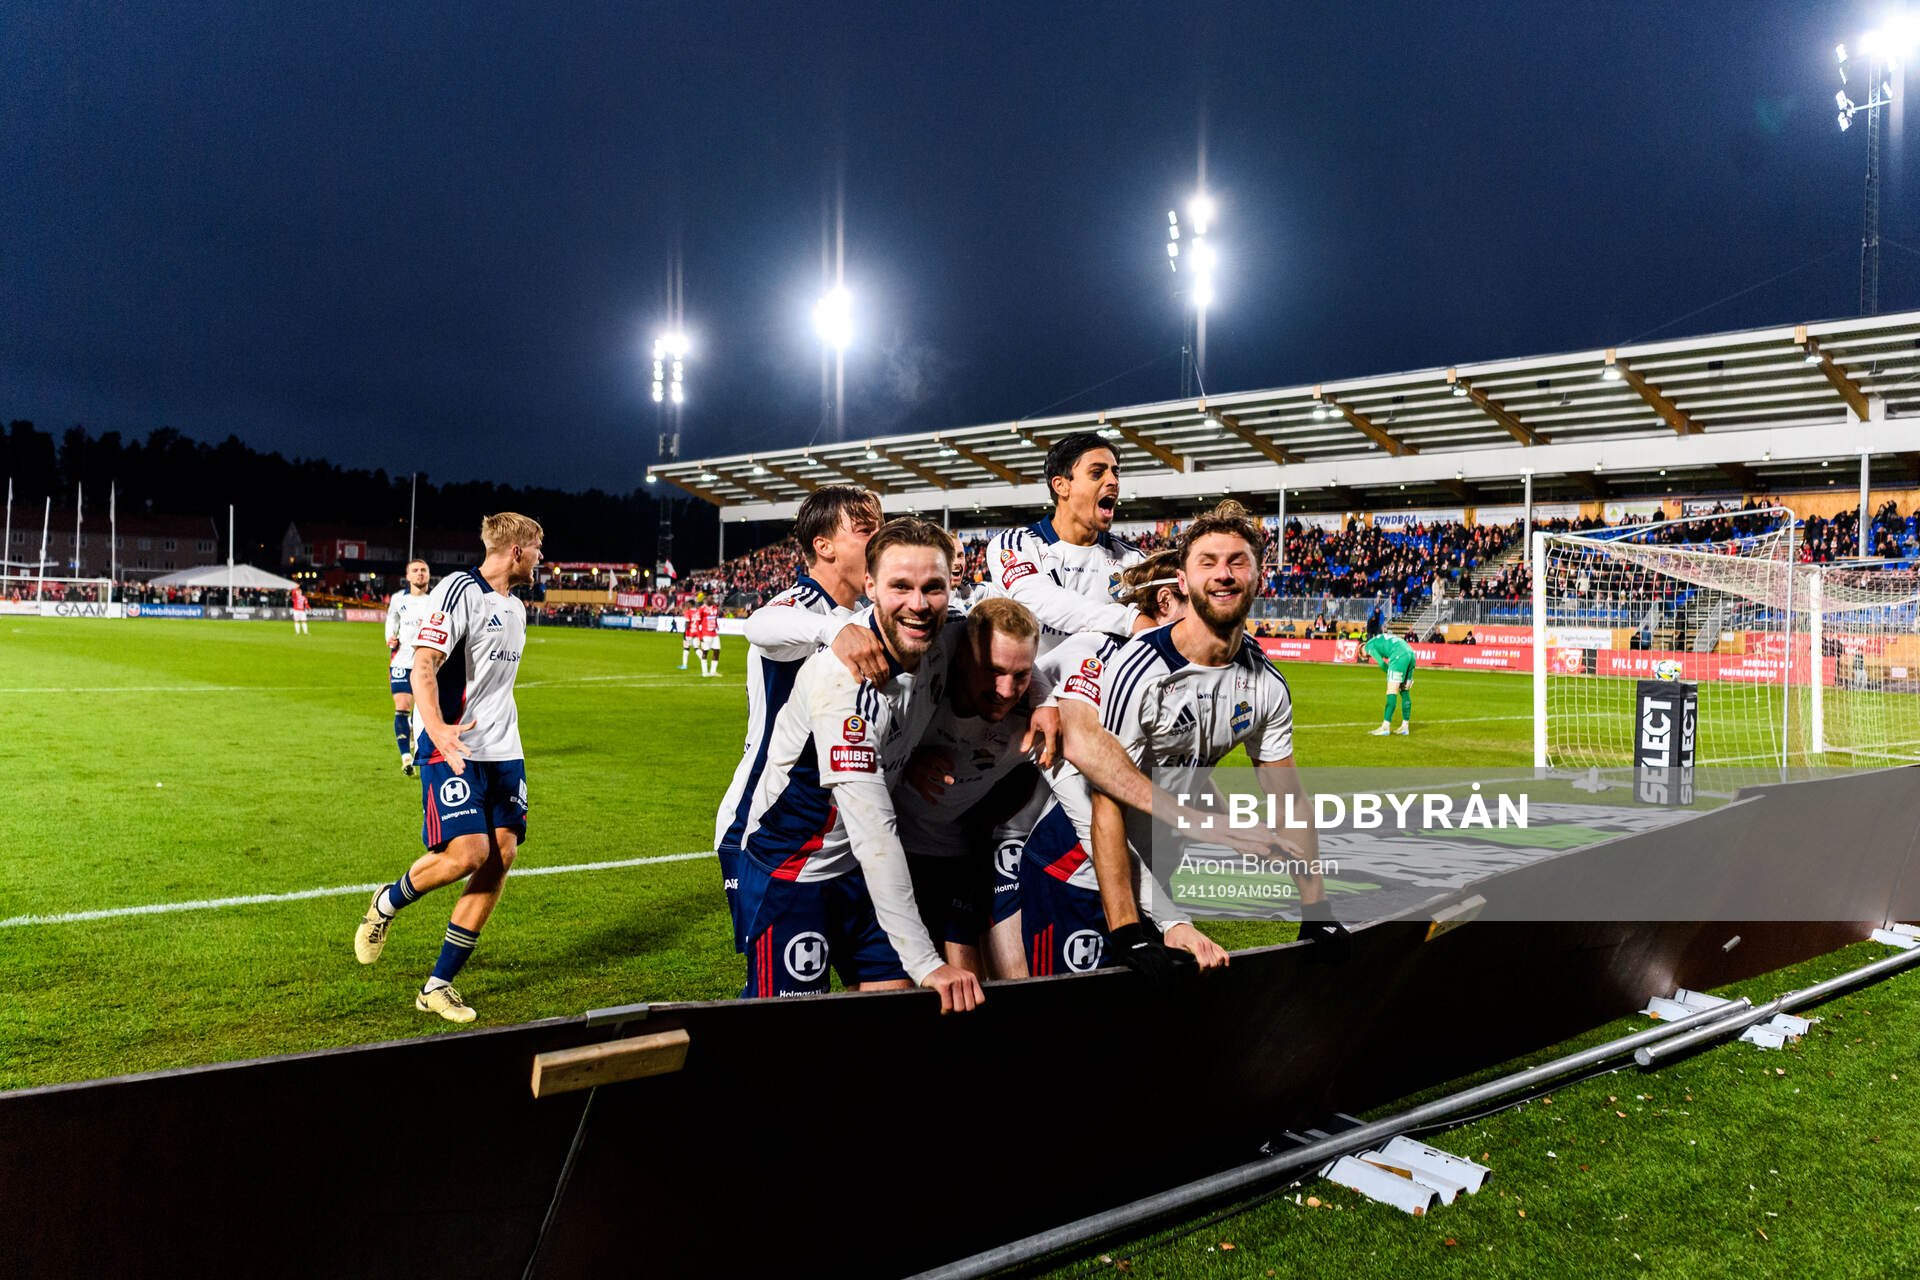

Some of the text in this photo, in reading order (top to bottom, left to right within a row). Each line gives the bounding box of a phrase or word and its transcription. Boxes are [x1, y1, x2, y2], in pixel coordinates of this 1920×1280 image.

[1002, 564, 1033, 584] UNIBET
[1611, 658, 1633, 669] VILL
[1634, 659, 1649, 670] DU
[851, 718, 859, 730] S
[832, 750, 875, 763] UNIBET
[1640, 696, 1672, 805] SELECT
[1680, 698, 1696, 805] SELECT
